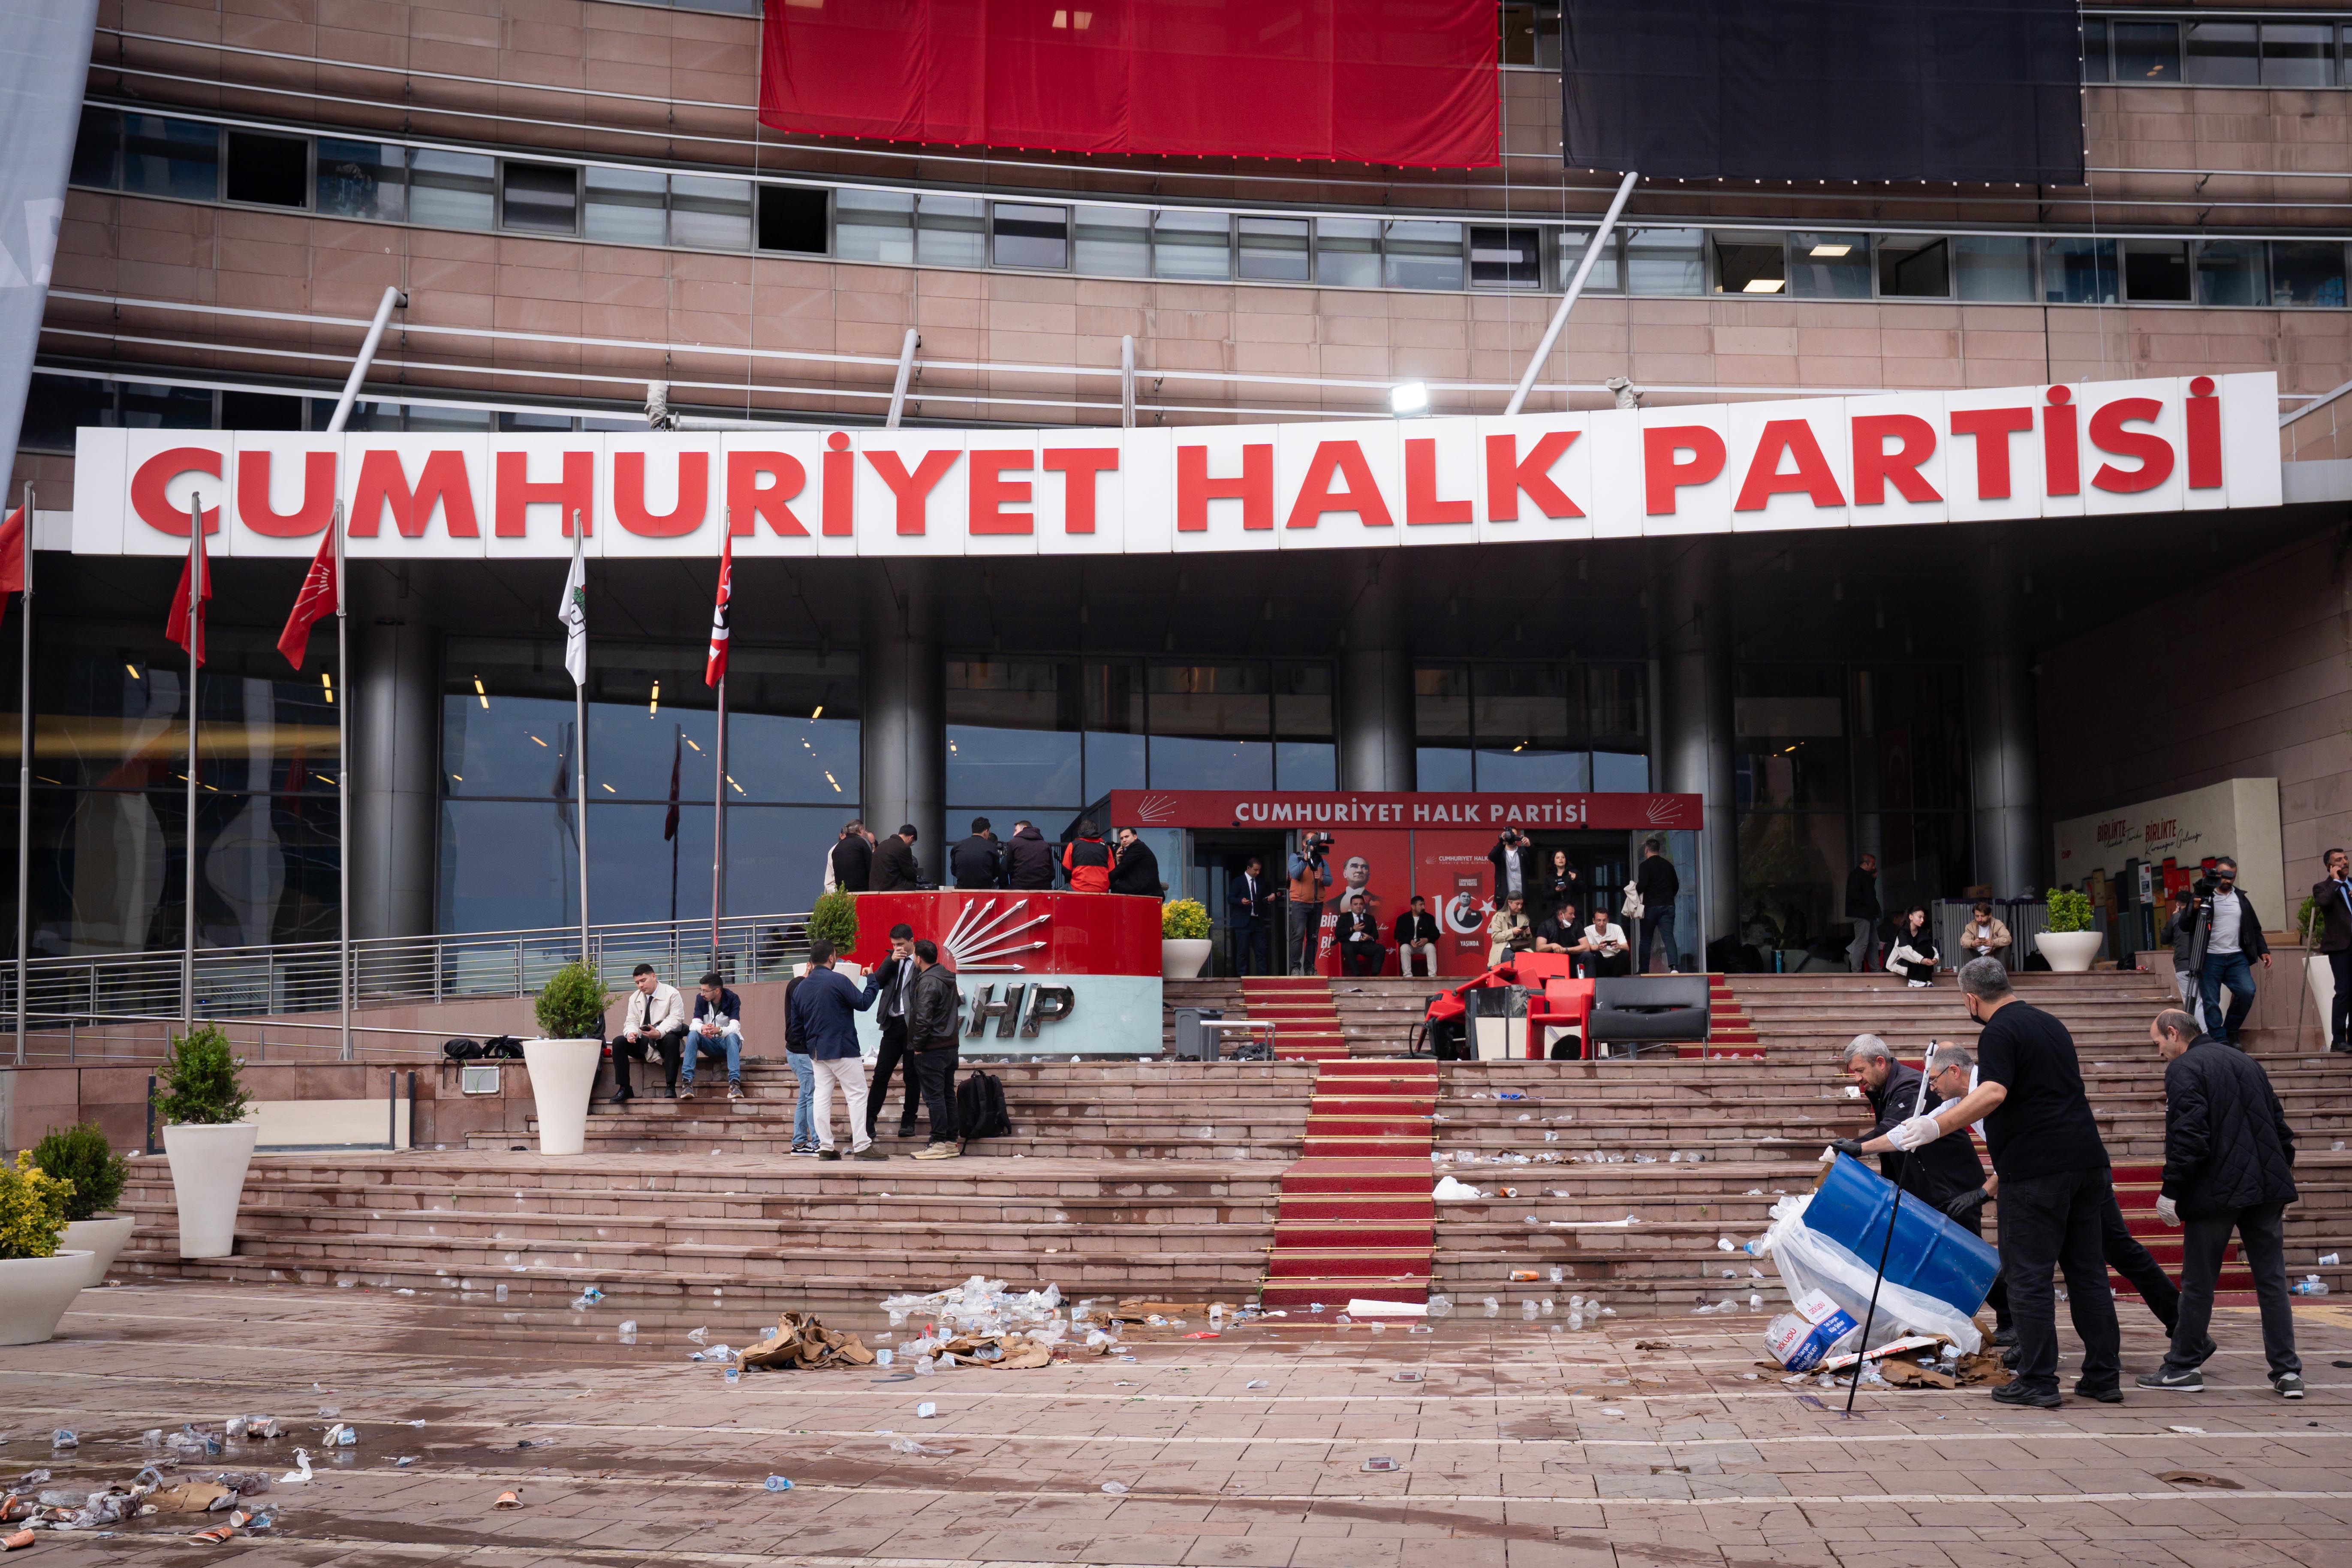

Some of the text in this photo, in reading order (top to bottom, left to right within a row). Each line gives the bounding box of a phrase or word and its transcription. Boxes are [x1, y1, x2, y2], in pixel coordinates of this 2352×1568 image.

[131, 376, 2223, 537] CUMHURİYET HALK PARTİSİ
[1235, 798, 1586, 822] CUMHURİYET HALK PARTİSİ
[2097, 818, 2177, 843] BİRLİKTE BİRLİKTE
